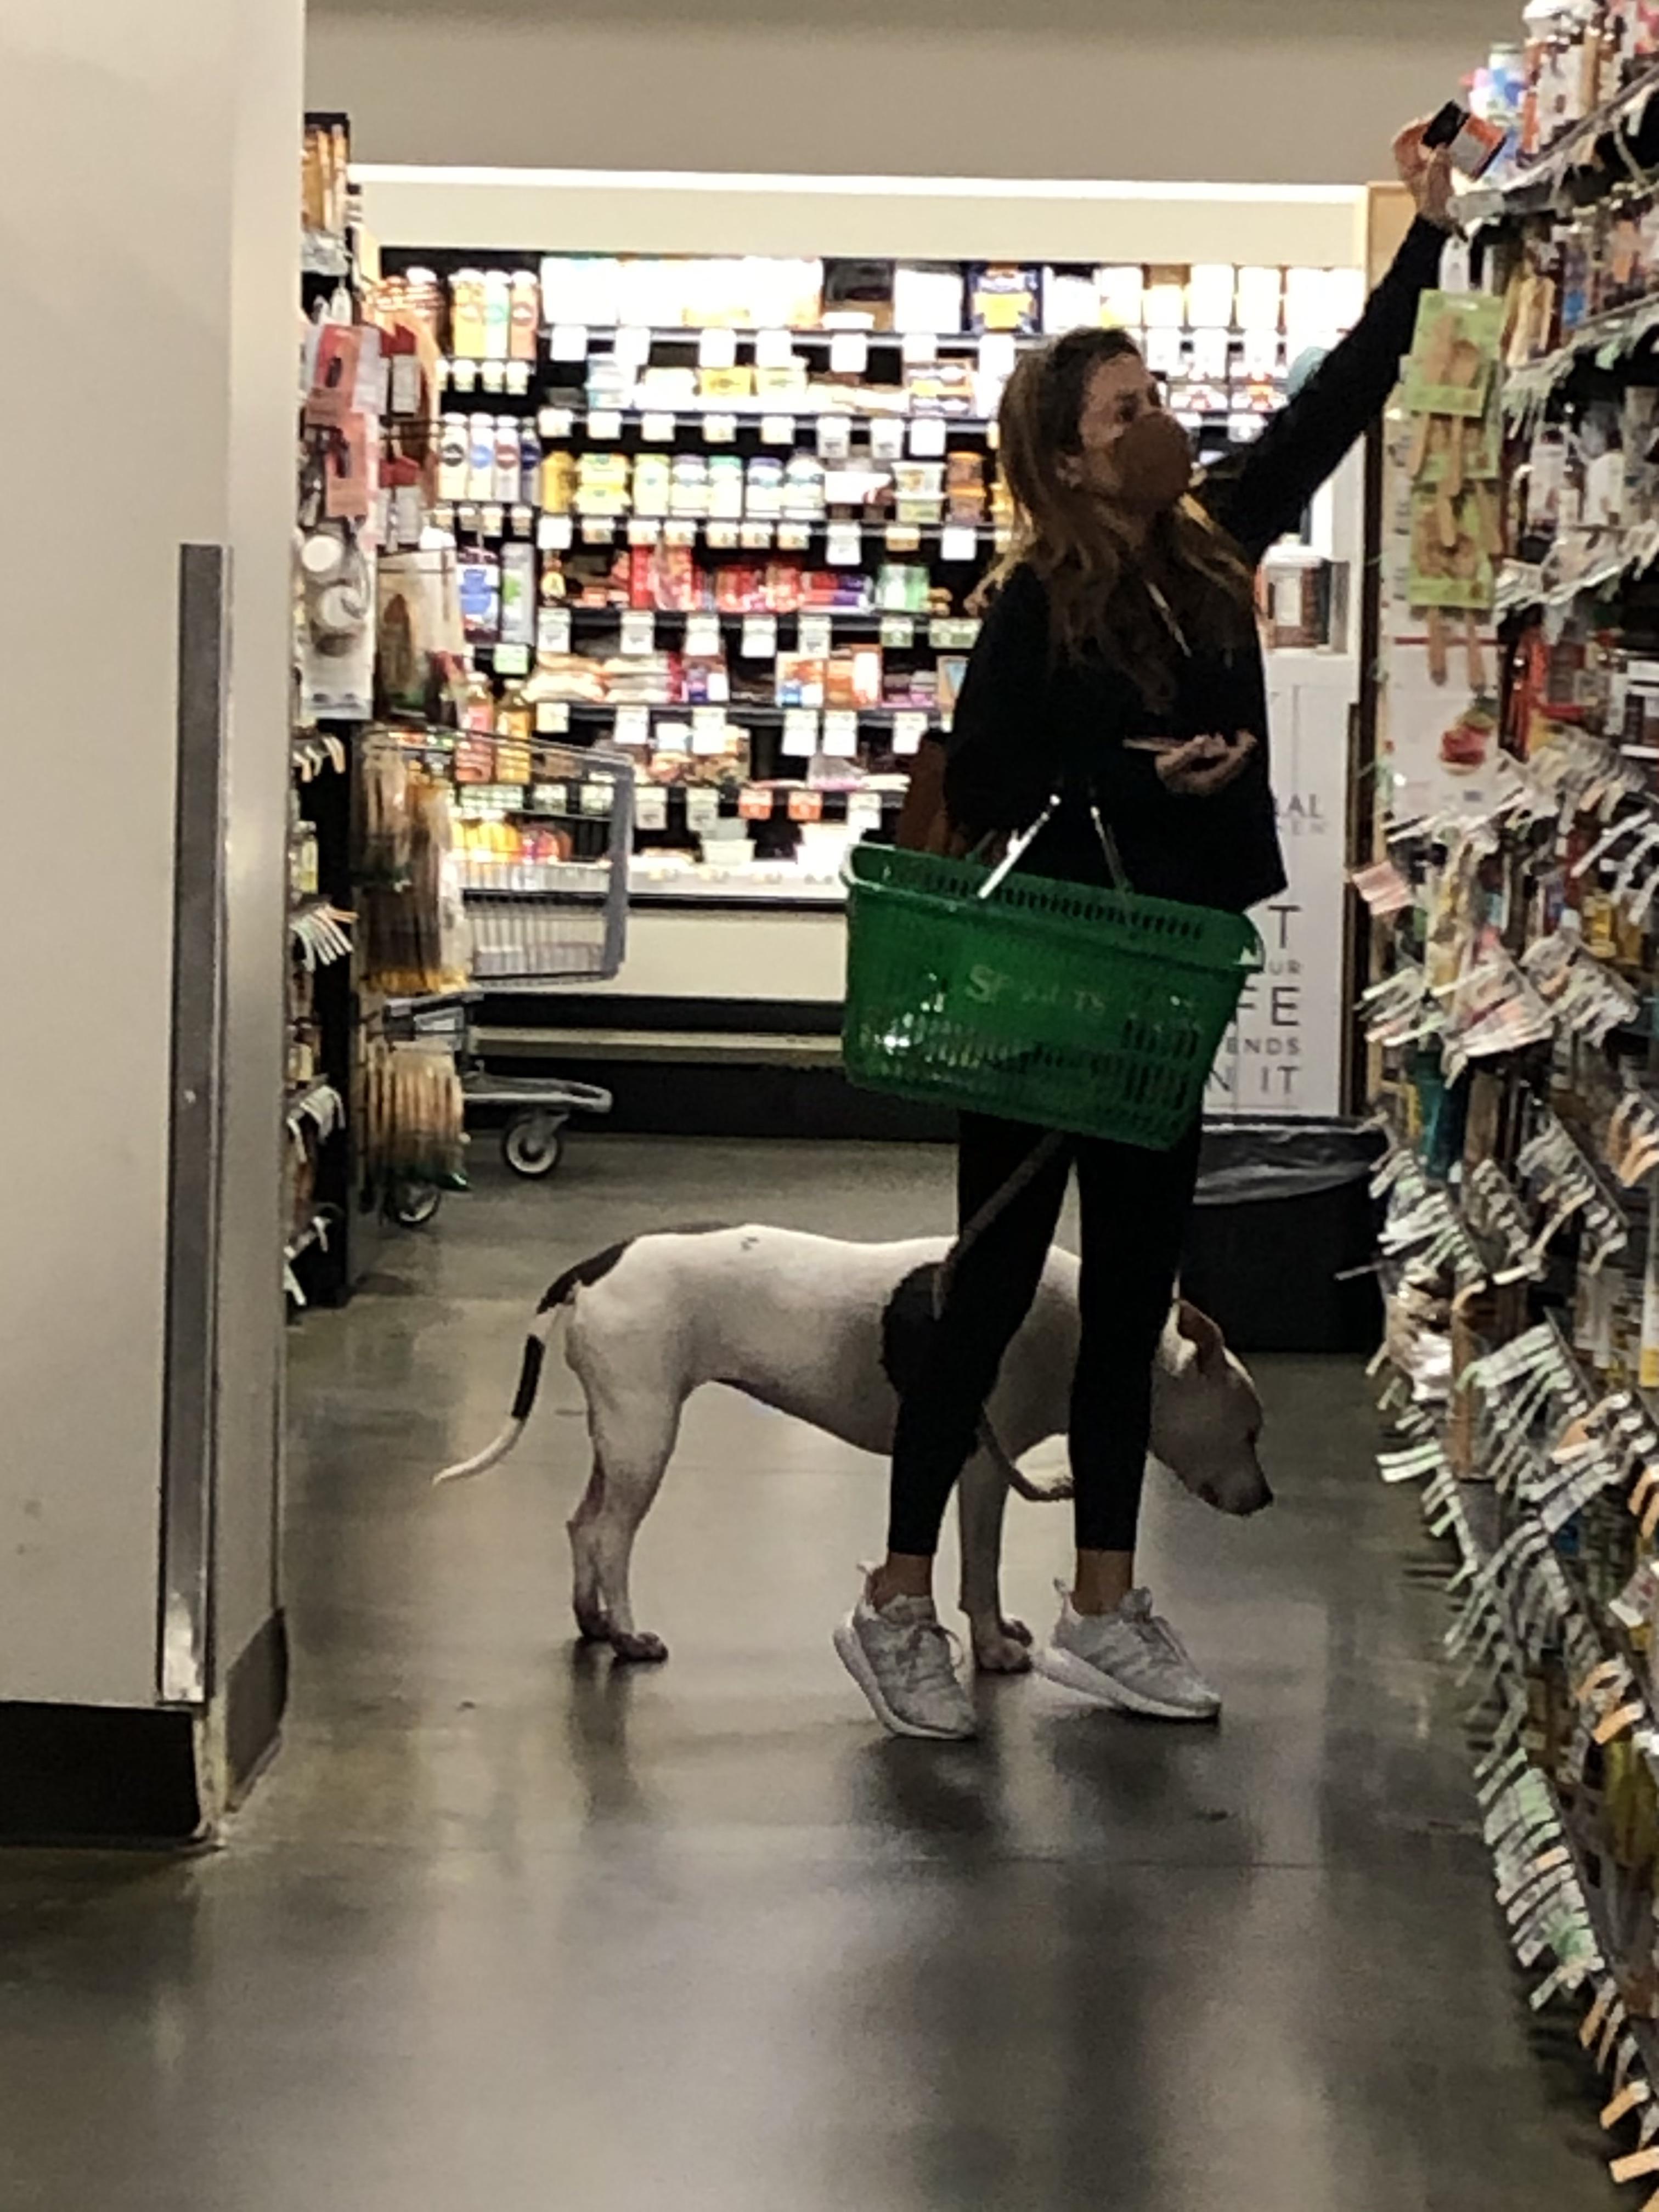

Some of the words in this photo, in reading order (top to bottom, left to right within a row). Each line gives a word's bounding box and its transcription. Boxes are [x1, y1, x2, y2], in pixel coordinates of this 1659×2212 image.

[1268, 905, 1301, 949] T
[1268, 960, 1301, 975] UR
[1237, 986, 1300, 1026] FE
[1226, 1036, 1301, 1055] ENDS
